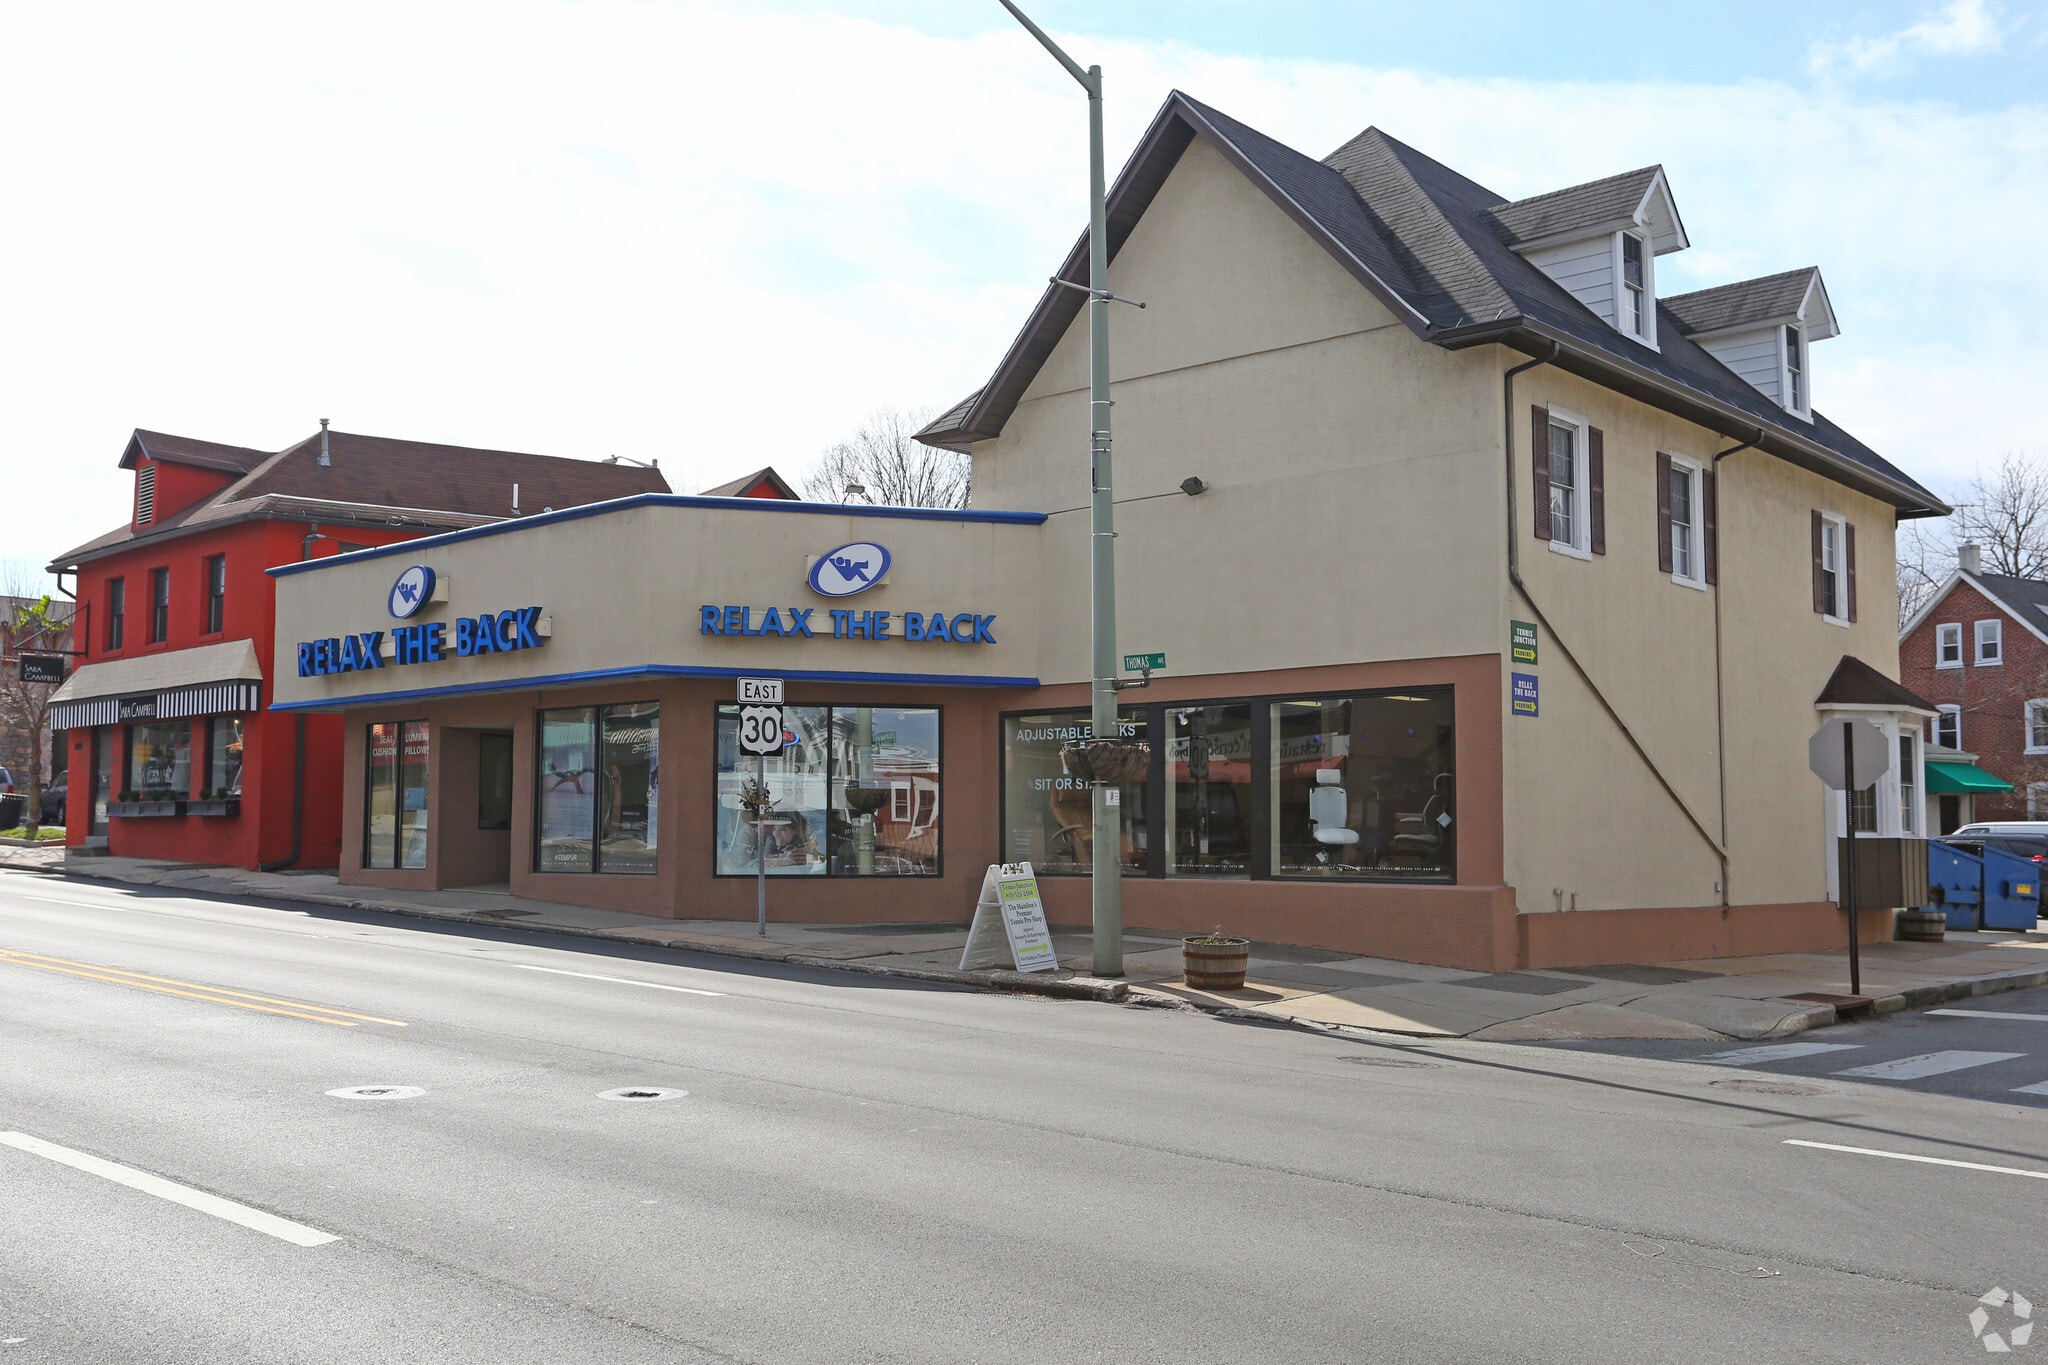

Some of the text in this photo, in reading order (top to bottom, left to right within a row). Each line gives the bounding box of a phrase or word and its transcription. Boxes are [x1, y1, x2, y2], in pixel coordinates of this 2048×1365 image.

[701, 605, 997, 644] RELAX THE BACK
[1516, 628, 1533, 638] TENNIS
[298, 606, 544, 677] RELAX THE BACK
[1513, 635, 1536, 646] JUNCTION
[1125, 656, 1150, 669] THOMAS
[24, 664, 42, 673] SARA
[24, 672, 61, 682] CAMPBELL
[744, 682, 777, 699] EAST
[1518, 680, 1533, 690] RELAX
[1514, 687, 1537, 698] THE BACK
[131, 702, 156, 718] CAMPBELL
[744, 715, 778, 744] 30
[1016, 726, 1091, 740] ADJUSTABLE
[379, 735, 393, 744] SEAT
[1034, 779, 1052, 791] SIT
[1055, 780, 1073, 790] OR
[1010, 918, 1024, 926] Tennis
